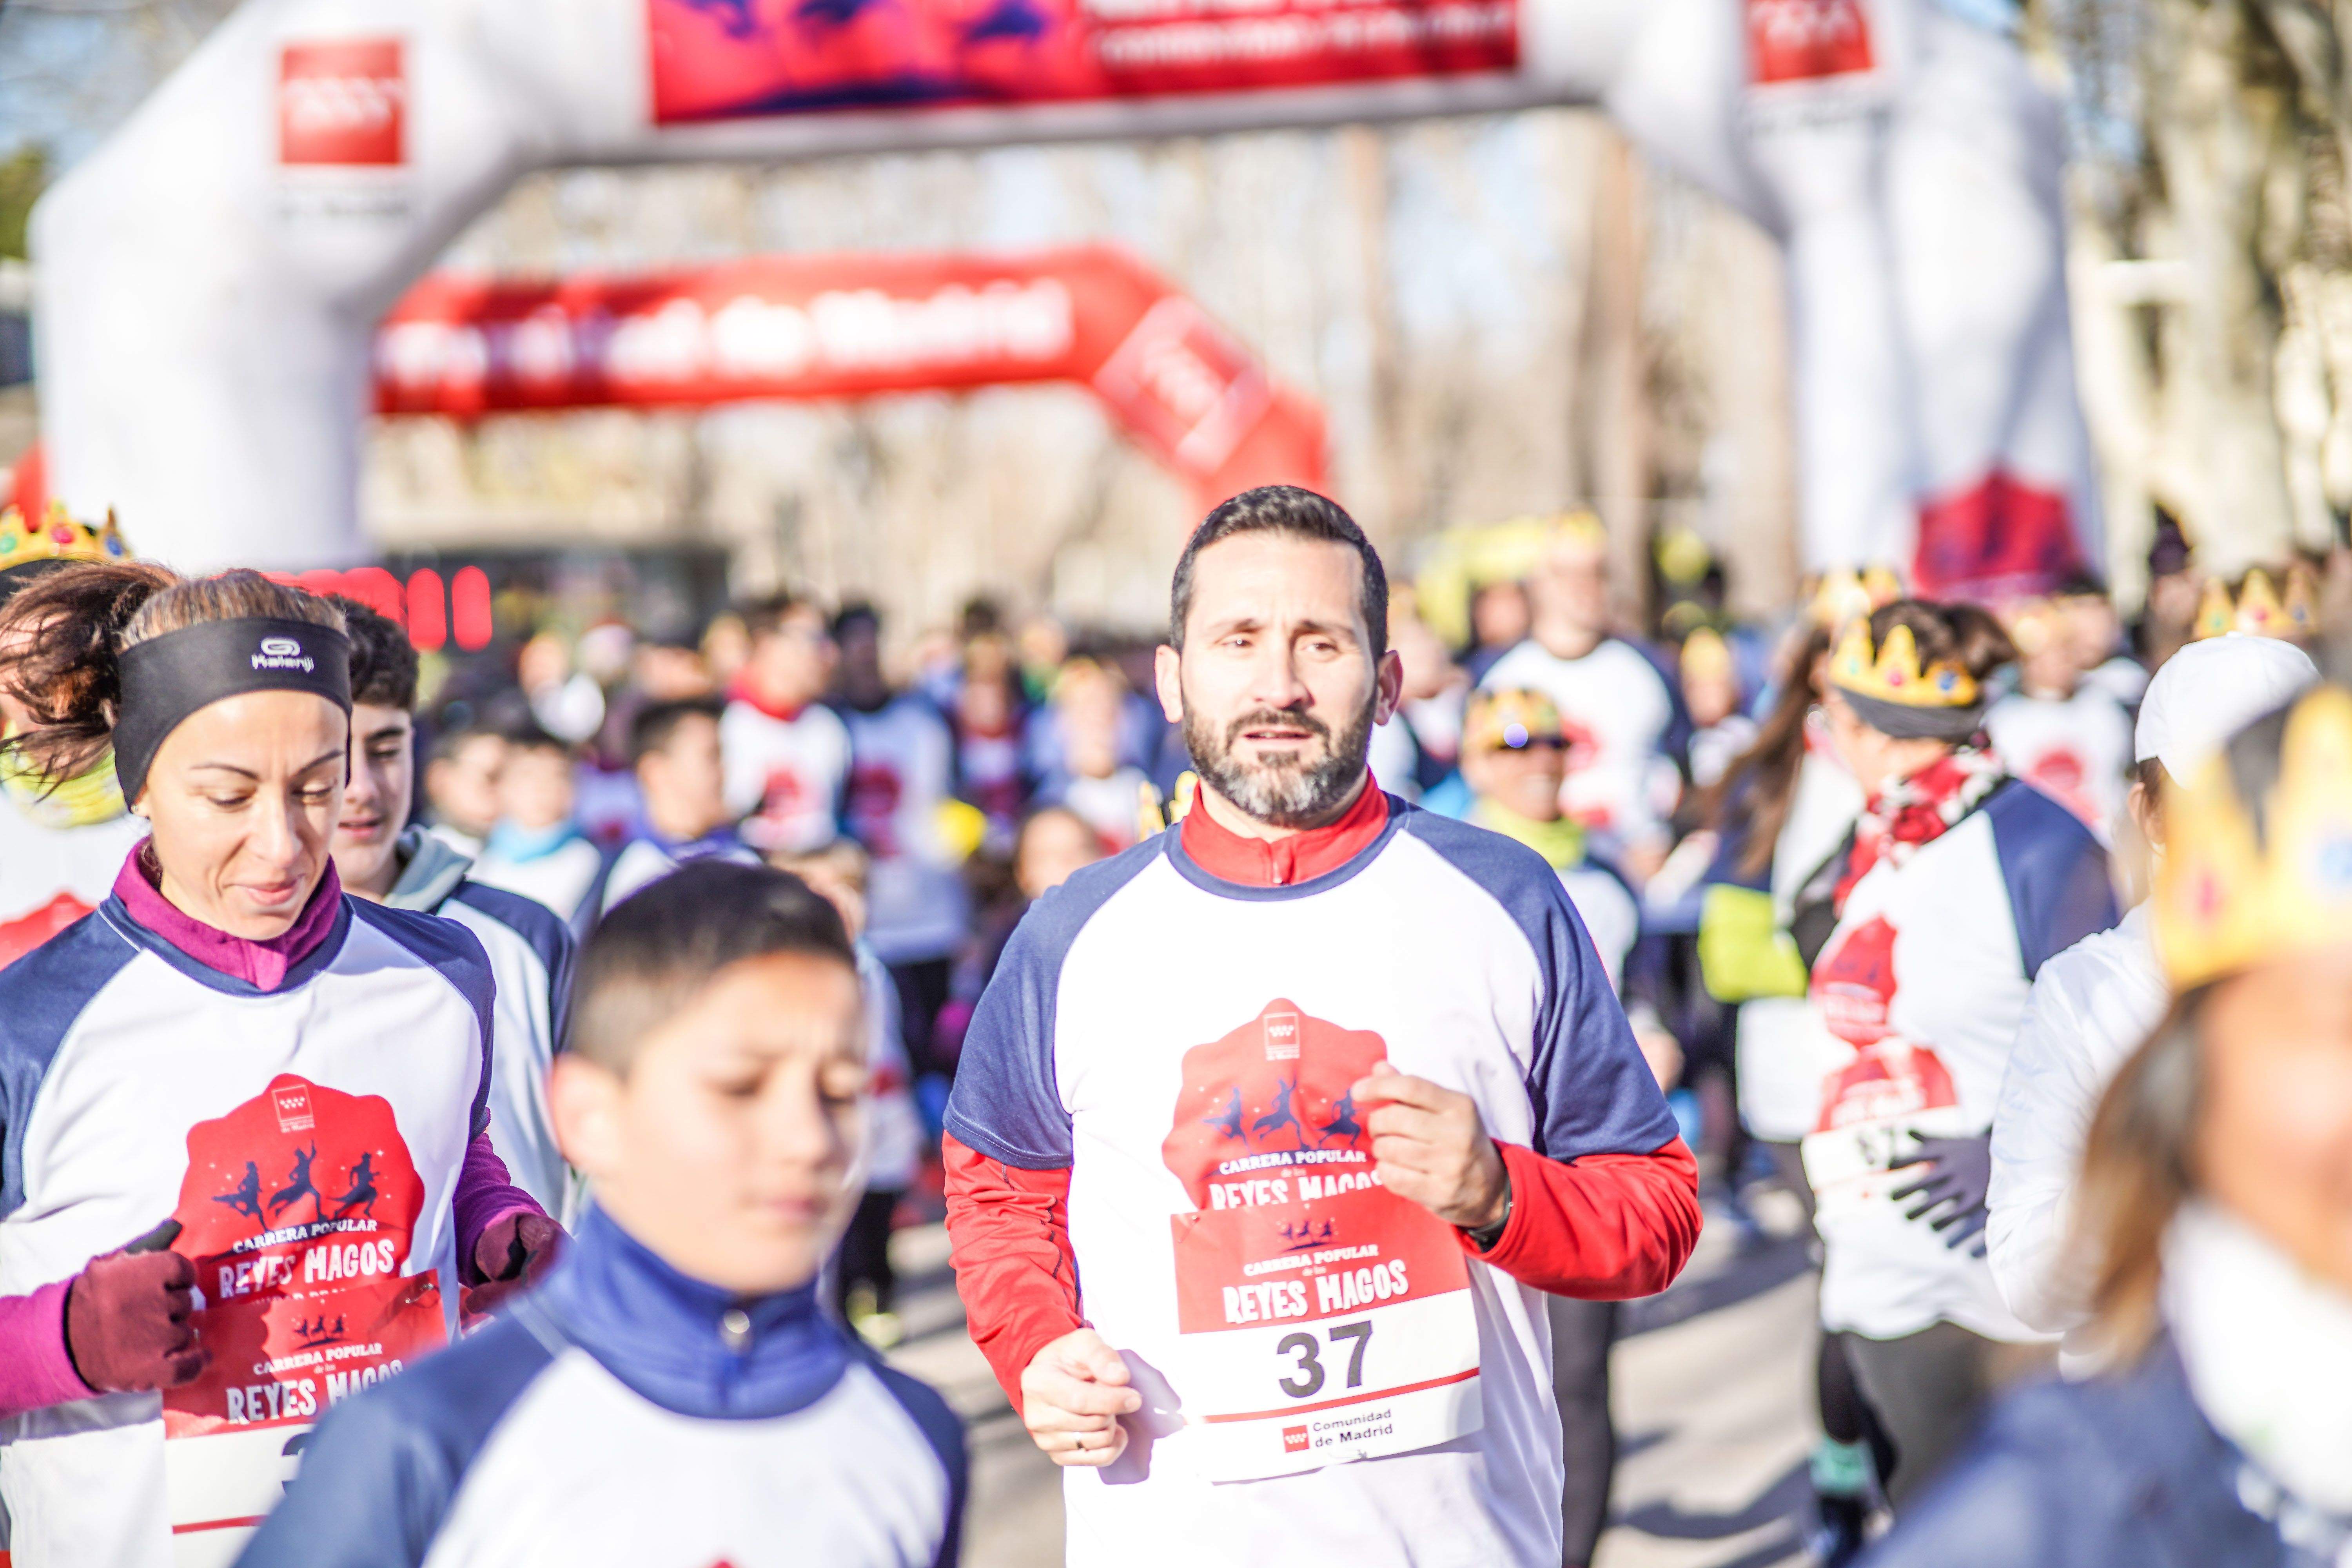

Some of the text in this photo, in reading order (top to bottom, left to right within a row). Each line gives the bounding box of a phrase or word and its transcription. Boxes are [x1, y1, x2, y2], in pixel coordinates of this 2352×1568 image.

[251, 654, 314, 673] Kalenji
[1219, 1150, 1367, 1175] CARRERA POPULAR
[233, 1226, 308, 1253] CARRERA
[311, 1219, 377, 1236] POPULAR
[219, 1255, 296, 1299] REYES
[304, 1239, 395, 1283] MAGOS
[1244, 1244, 1379, 1276] CARRERA POPULAR
[1223, 1259, 1409, 1324] REYES MAGOS
[253, 1343, 383, 1375] CARRERA POPULAR
[1277, 1320, 1373, 1398] 37
[226, 1378, 317, 1425] REYES
[1313, 1409, 1391, 1432] Comunidad
[1316, 1424, 1393, 1447] de Madrid
